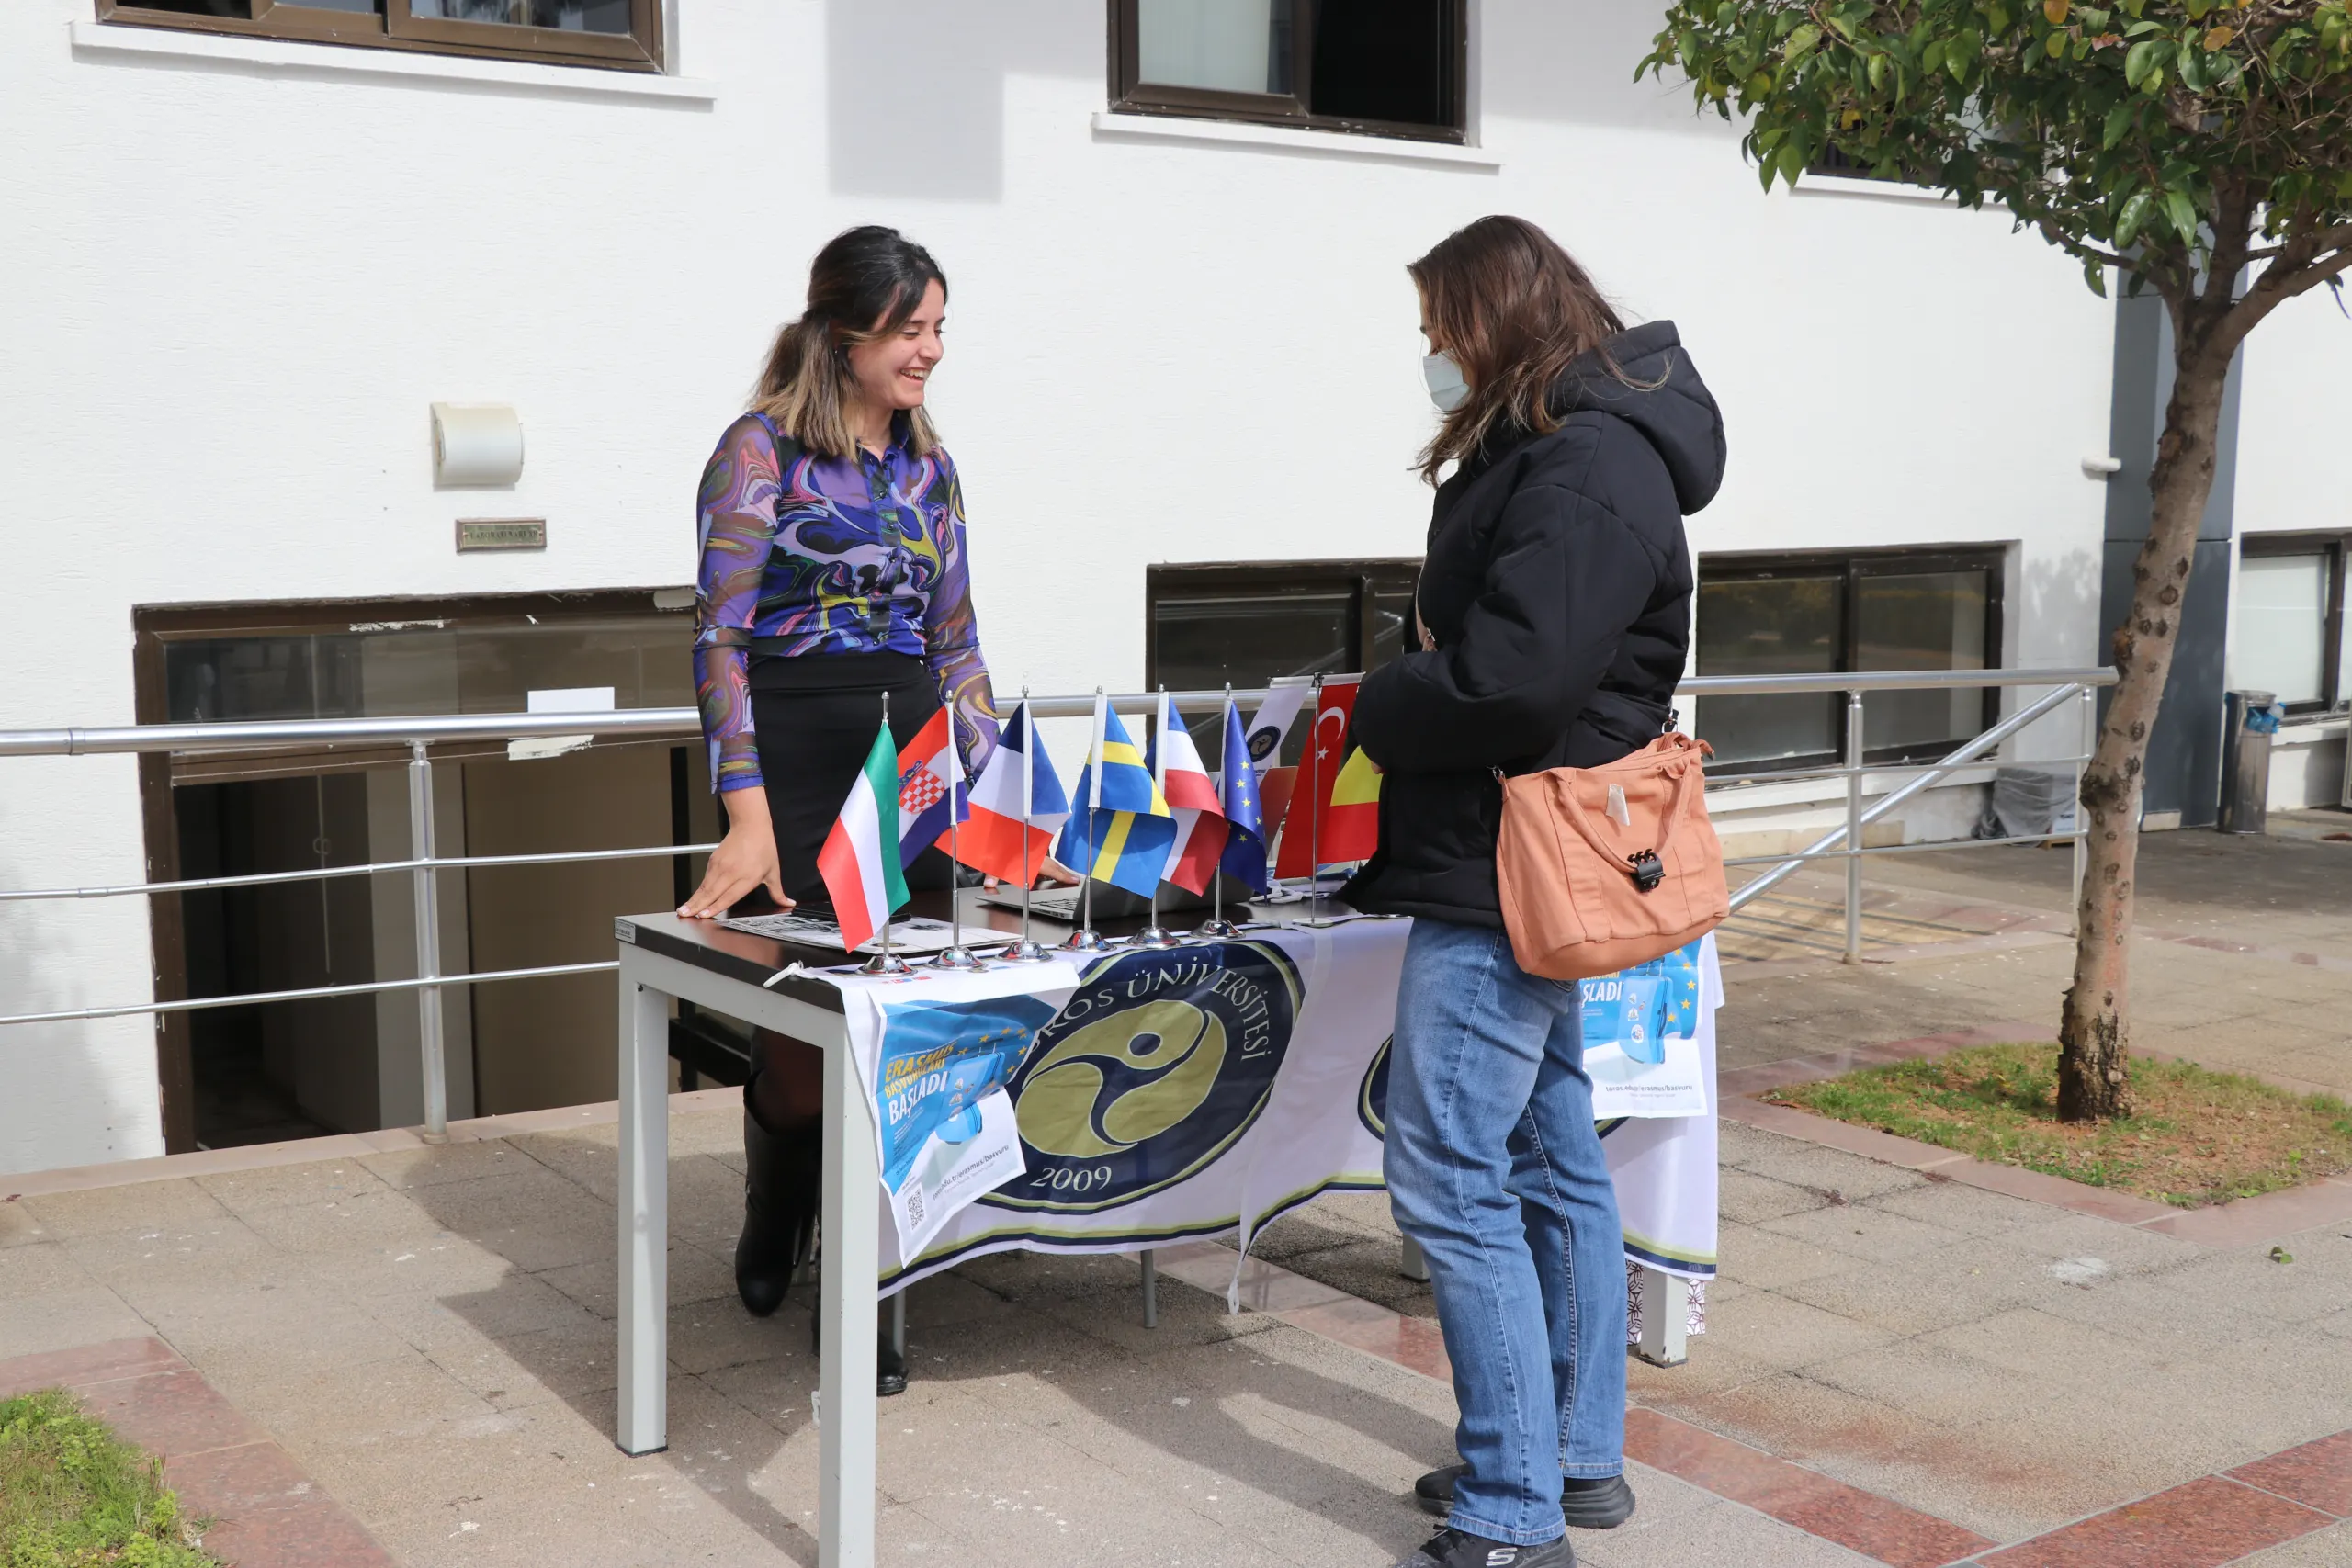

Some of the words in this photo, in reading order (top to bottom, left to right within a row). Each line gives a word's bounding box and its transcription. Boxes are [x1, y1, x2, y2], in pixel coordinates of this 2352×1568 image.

[1127, 956, 1272, 1060] ÜNİVERSİTESİ
[1581, 981, 1623, 1009] ŞLADI
[886, 1042, 957, 1082] ERASMUS
[889, 1071, 948, 1125] BAŞLADI
[1030, 1166, 1112, 1192] 2009
